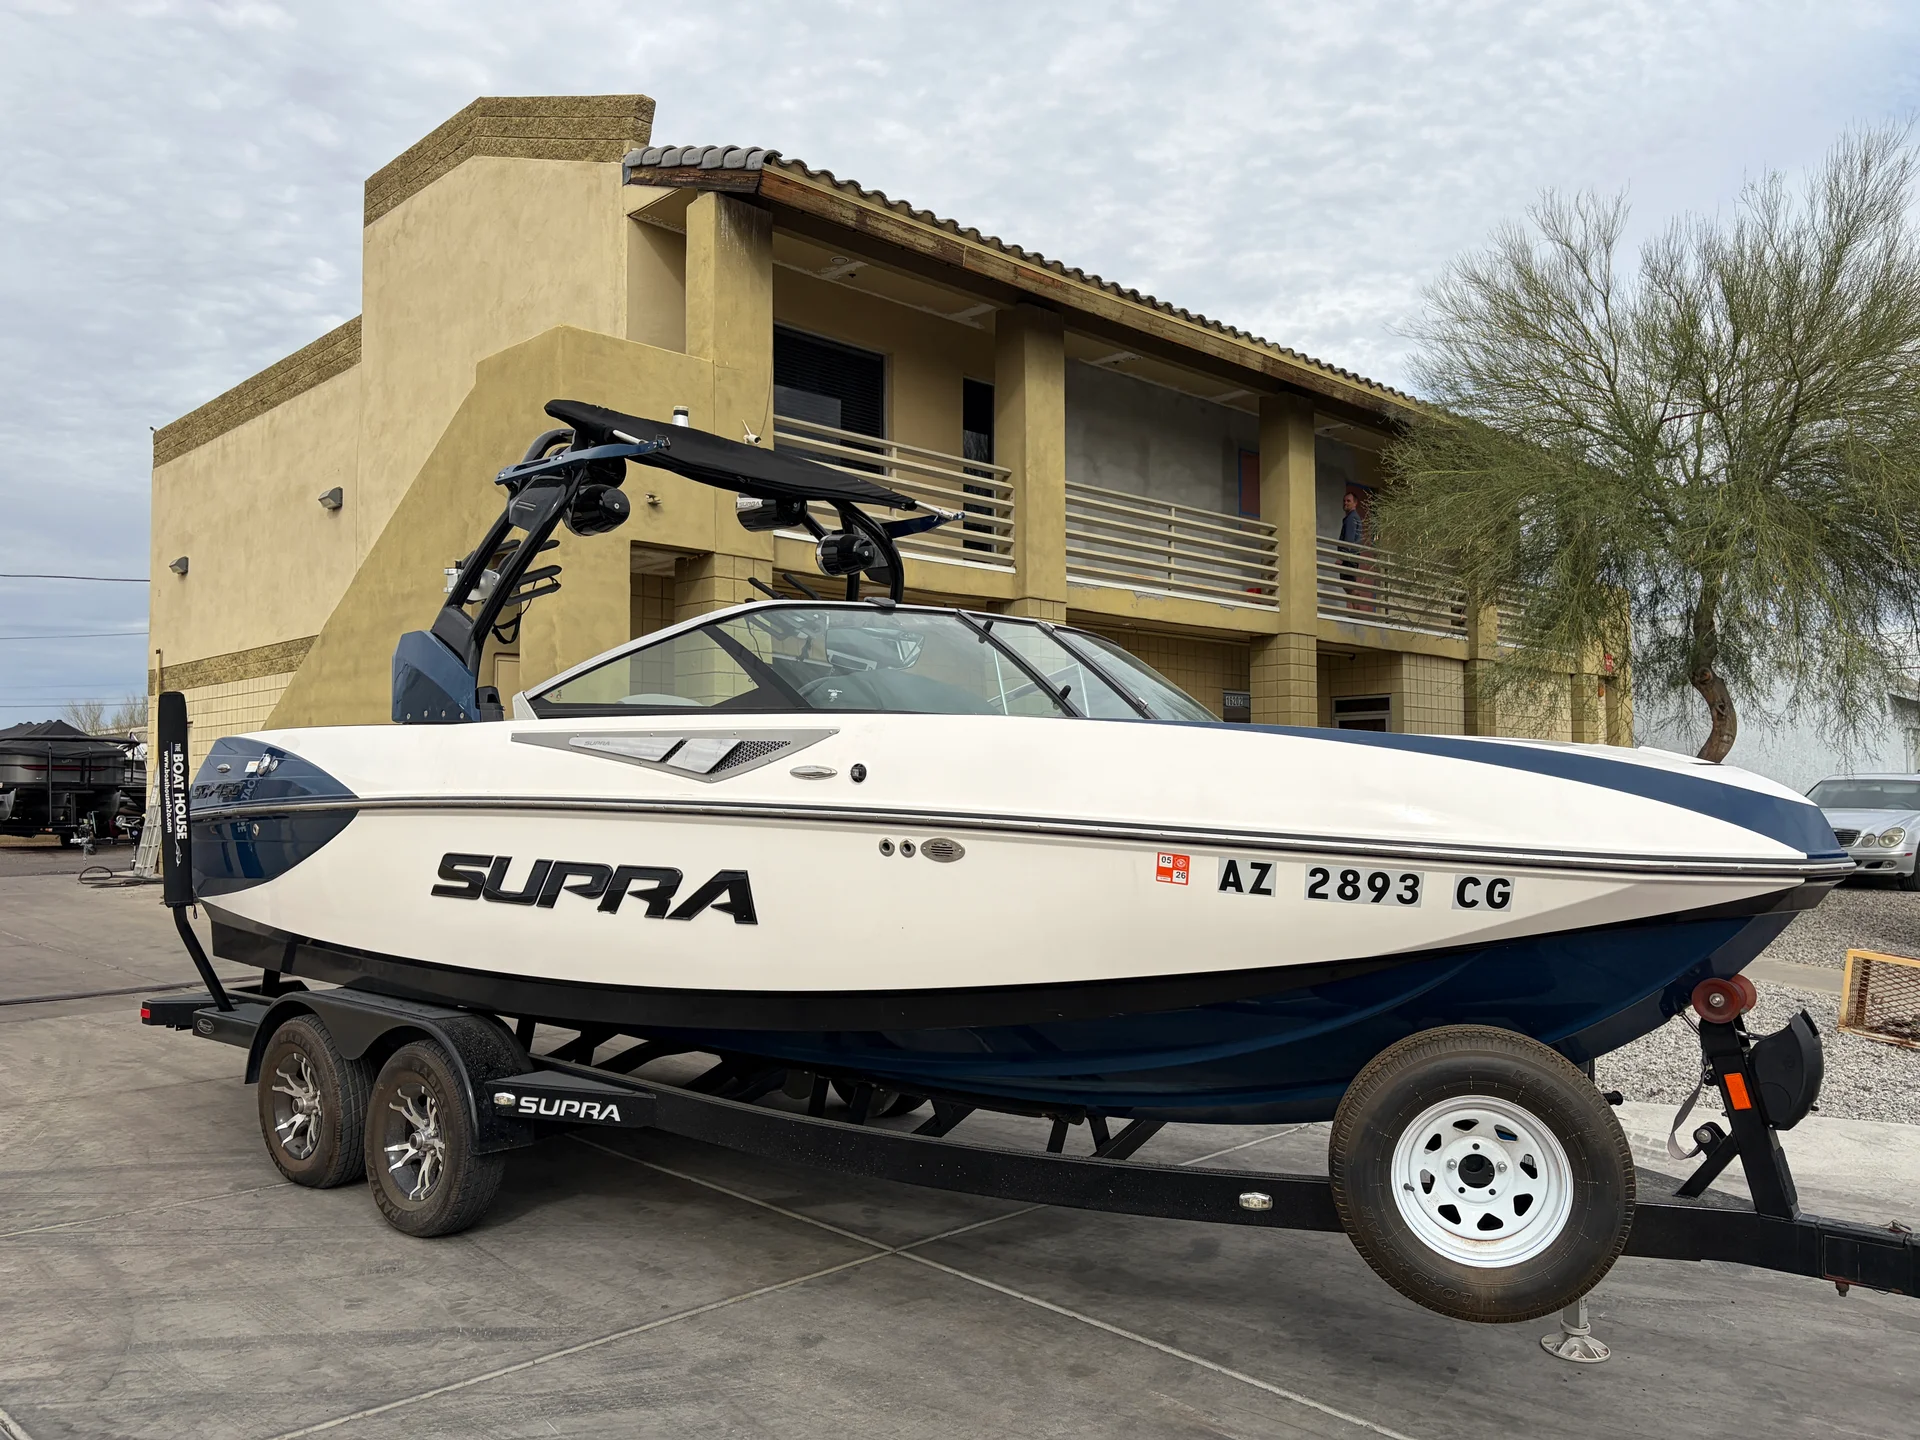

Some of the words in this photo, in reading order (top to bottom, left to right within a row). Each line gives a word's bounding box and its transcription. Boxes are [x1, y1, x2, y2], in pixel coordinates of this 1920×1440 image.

[174, 743, 182, 752] THE
[172, 753, 185, 790] BOAT
[163, 750, 173, 833] www.boathouseh2o.com
[174, 793, 188, 840] HOUSE
[1161, 856, 1172, 864] 05
[1175, 871, 1186, 879] 26
[430, 851, 758, 925] SUPRA
[1218, 859, 1274, 896] AZ
[1307, 866, 1420, 905] 2893
[1456, 876, 1511, 910] CG
[518, 1096, 621, 1122] SUPRA
[1411, 1272, 1473, 1304] LOAD
